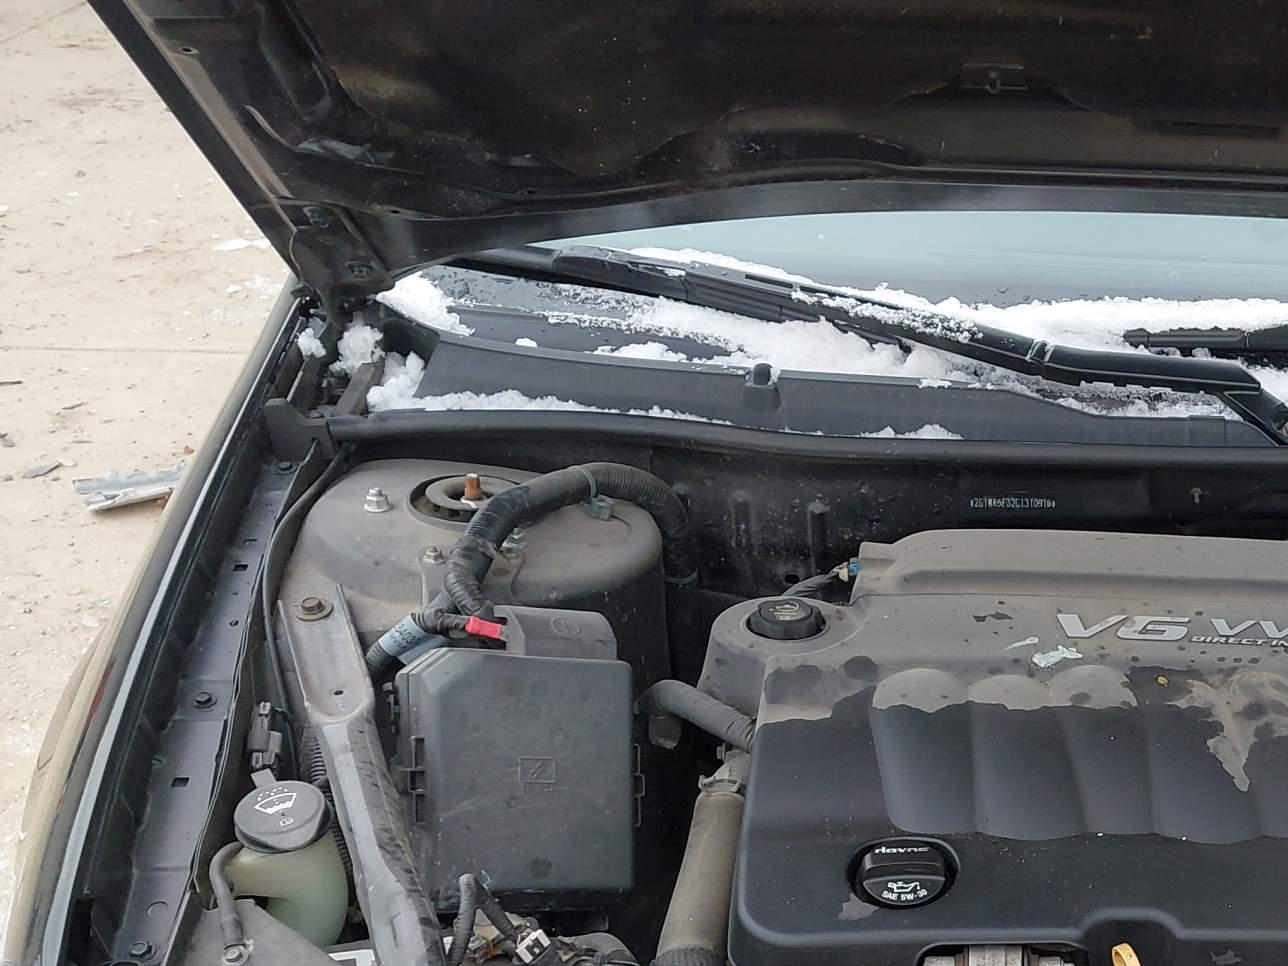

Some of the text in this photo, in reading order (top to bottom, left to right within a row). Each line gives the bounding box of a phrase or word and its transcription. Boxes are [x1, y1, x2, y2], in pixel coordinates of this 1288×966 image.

[1057, 614, 1191, 640] V6
[1190, 636, 1267, 645] DIRECT
[881, 888, 928, 901] SAE 5W-30
